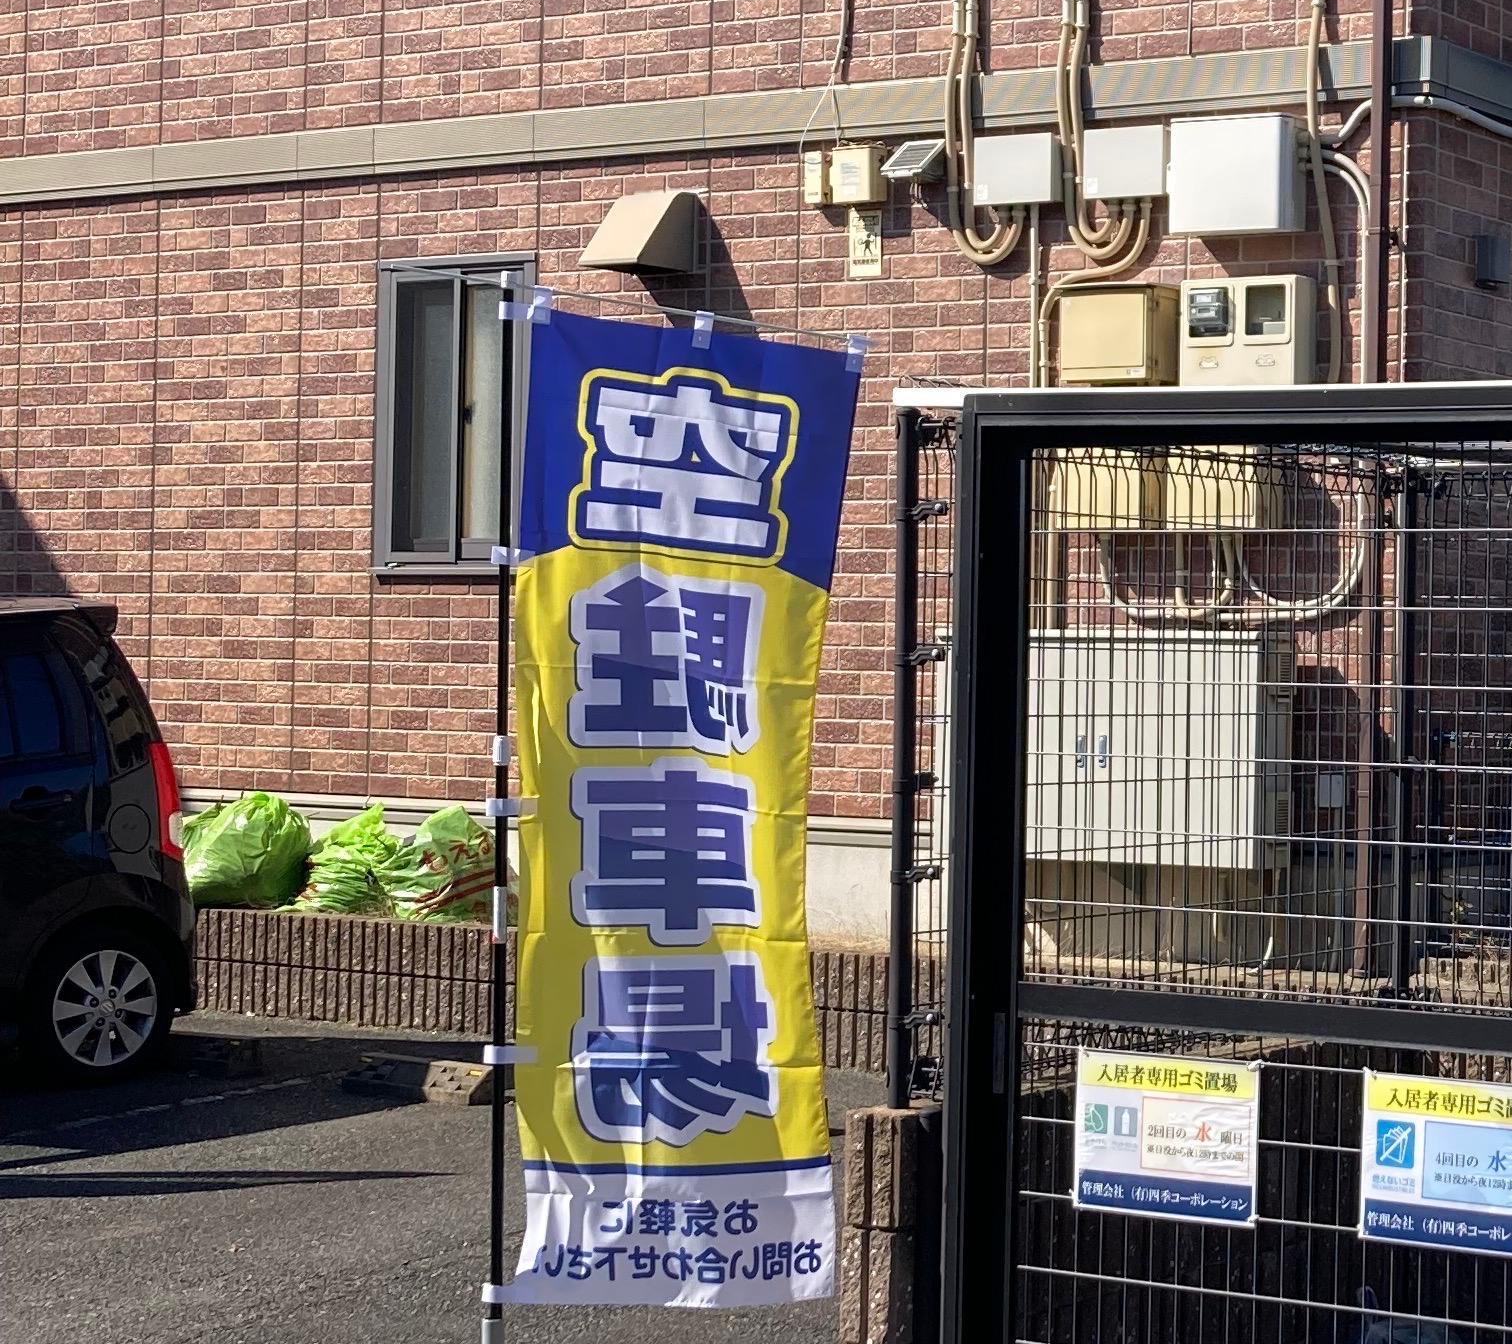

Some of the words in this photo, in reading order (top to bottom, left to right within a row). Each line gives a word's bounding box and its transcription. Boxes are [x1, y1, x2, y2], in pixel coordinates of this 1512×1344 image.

[1097, 1063, 1239, 1094] 入居者専用ゴミ置場
[1147, 1124, 1187, 1140] 2回目の
[1194, 1121, 1212, 1143] 水
[1220, 1130, 1244, 1146] 曜日
[1435, 1151, 1479, 1168] 4回目の
[1487, 1150, 1507, 1173] 水
[1081, 1180, 1125, 1199] 管理会社
[1131, 1186, 1249, 1212] (有)四季コーポレーション
[1366, 1210, 1415, 1231] 管理会社
